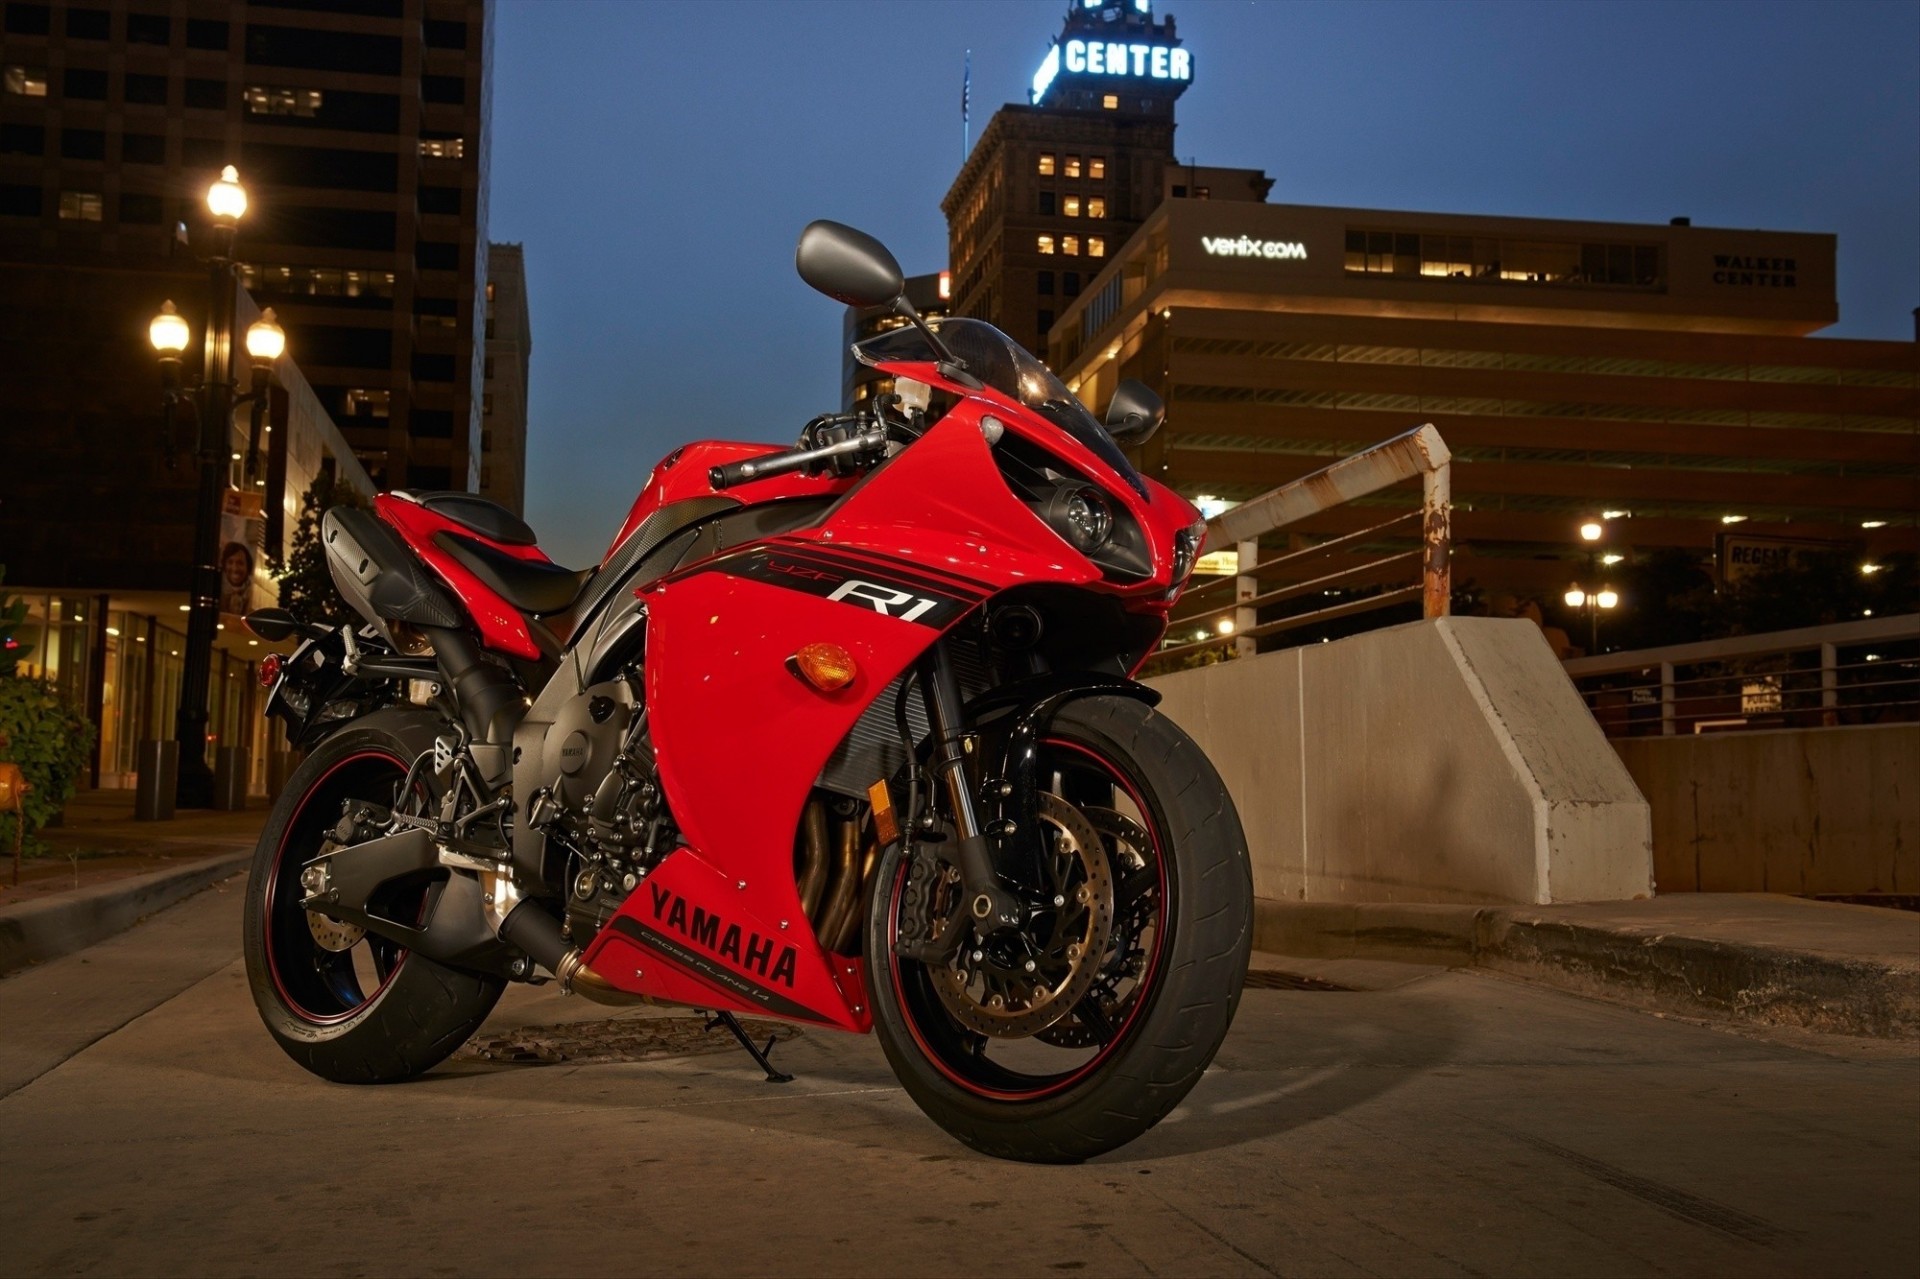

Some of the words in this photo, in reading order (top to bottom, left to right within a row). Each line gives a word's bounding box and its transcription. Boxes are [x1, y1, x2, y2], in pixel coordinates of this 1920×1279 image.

[1066, 40, 1190, 79] CENTER
[1713, 255, 1797, 271] WALKER
[1713, 272, 1796, 287] CENTER
[826, 580, 938, 622] R1
[651, 881, 797, 989] YAMAHA
